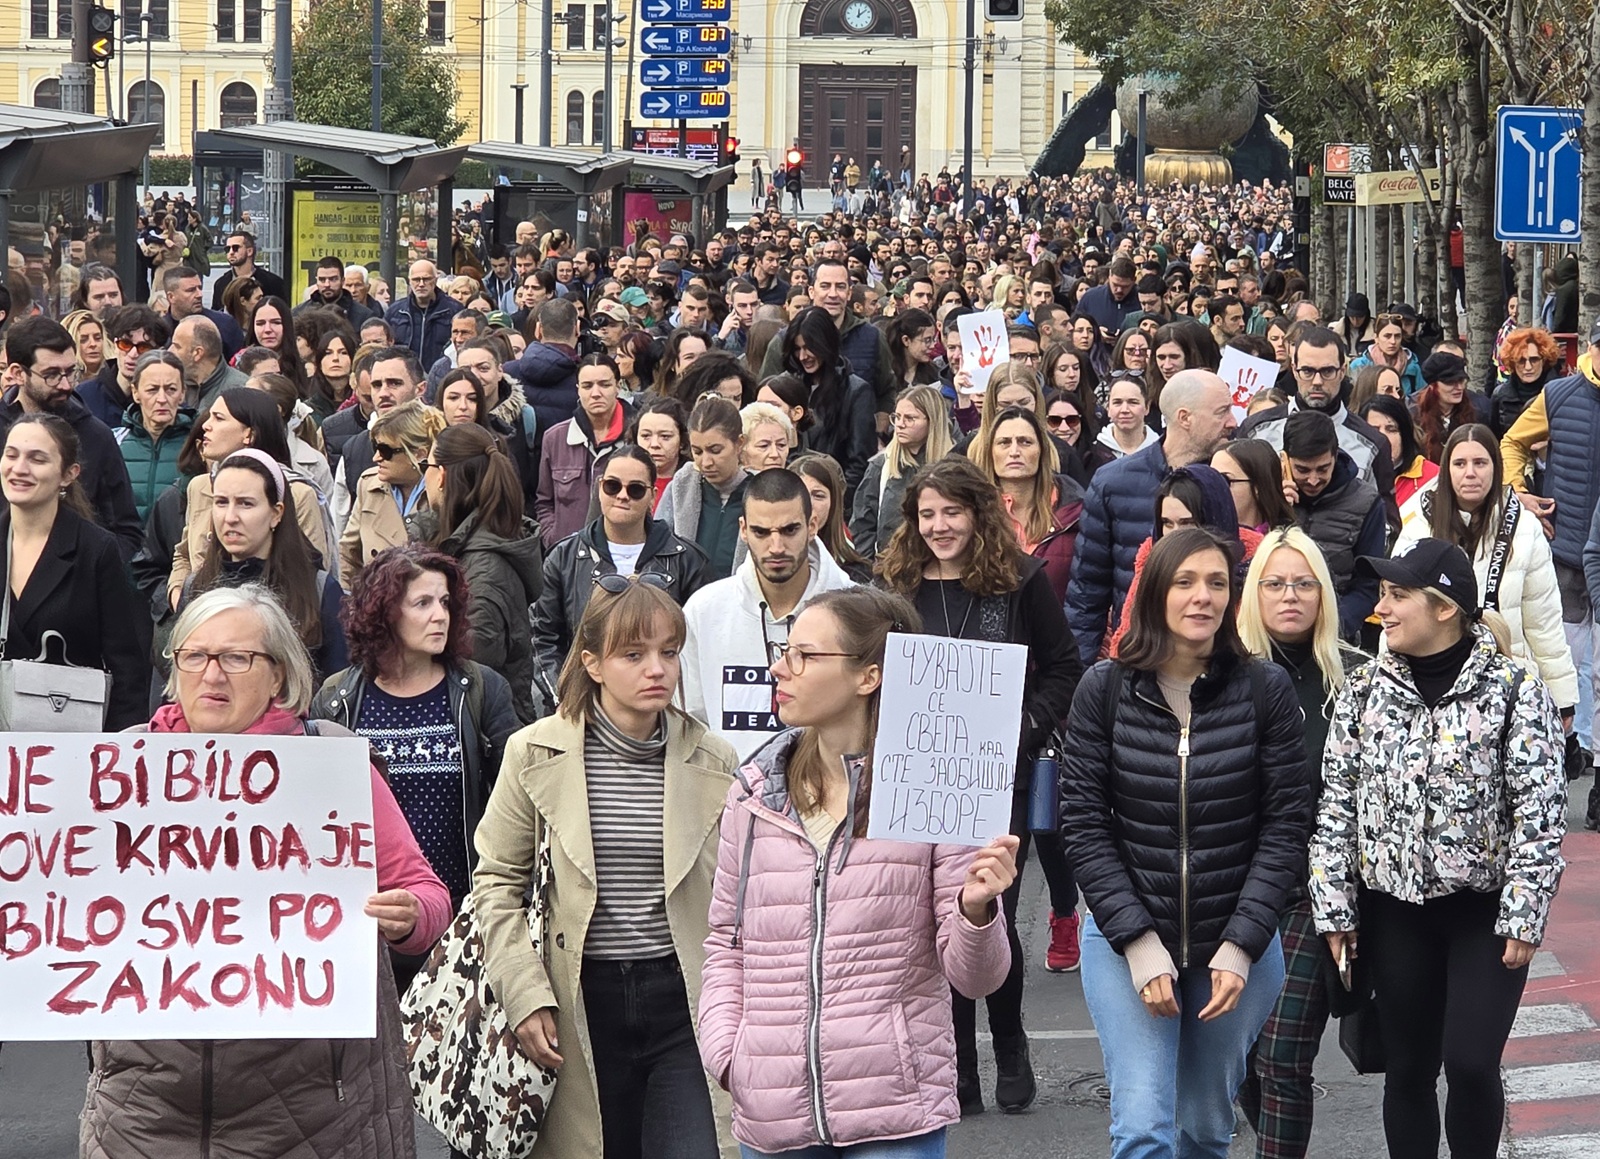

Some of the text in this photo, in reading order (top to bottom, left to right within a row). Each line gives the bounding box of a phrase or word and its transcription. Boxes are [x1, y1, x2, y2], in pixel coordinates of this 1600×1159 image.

[700, 28, 726, 42] 037
[704, 60, 726, 73] 124
[700, 92, 725, 105] 000
[314, 213, 343, 223] HANGAR
[311, 248, 348, 258] VELIKI
[1487, 540, 1507, 593] MONCLER
[903, 639, 1003, 696] ЧУВАЈТЕ
[927, 691, 945, 713] СЕ
[979, 740, 1005, 758] КАД
[880, 753, 914, 783] СТЕ
[888, 788, 993, 839] ИЗБОРЕ
[137, 894, 245, 951] SVE
[269, 892, 344, 943] PO
[47, 951, 335, 1014] ZAKONU
